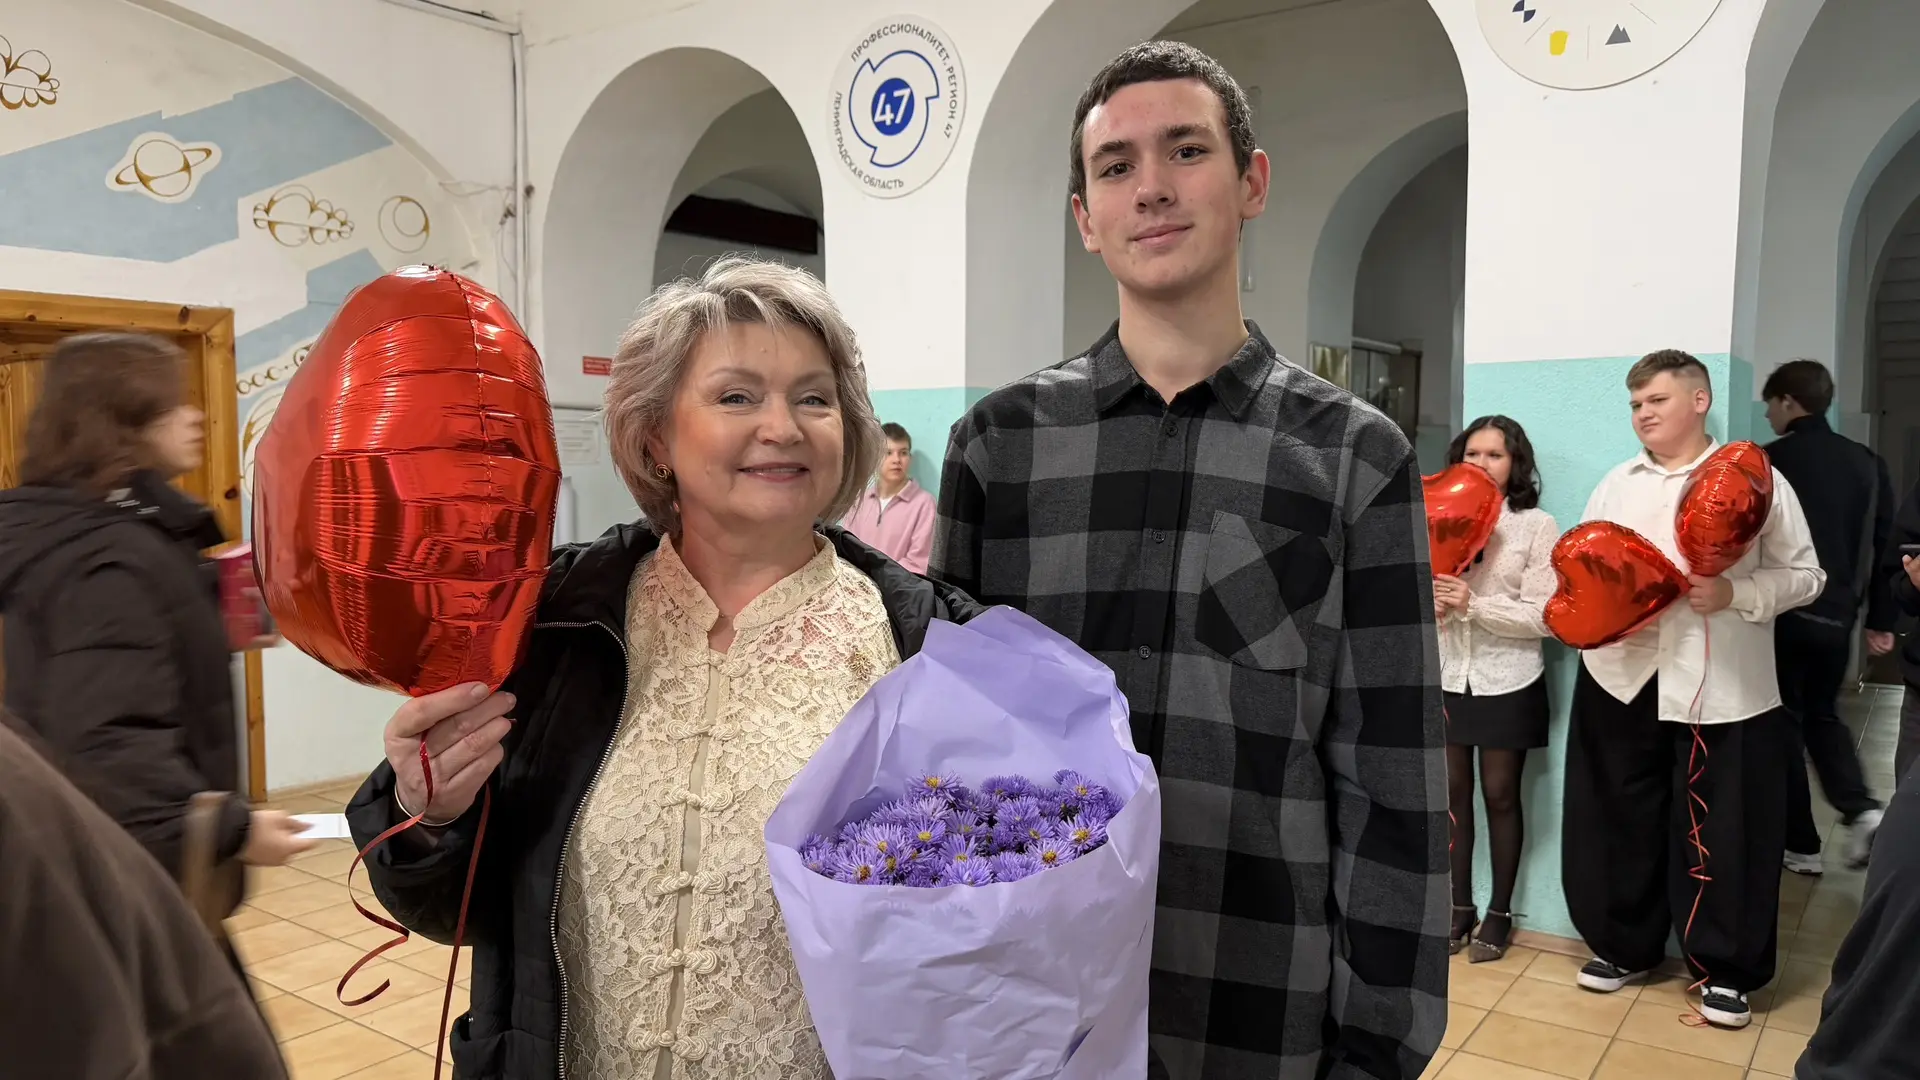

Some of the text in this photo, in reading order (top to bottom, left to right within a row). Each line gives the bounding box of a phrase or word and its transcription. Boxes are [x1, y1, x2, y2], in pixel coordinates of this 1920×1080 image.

[873, 87, 911, 126] 47
[946, 65, 958, 119] РЕГИОН
[832, 91, 904, 190] ЛЕНИНГРАДСКАЯ ОБЛАСТЬ
[943, 124, 953, 139] 47
